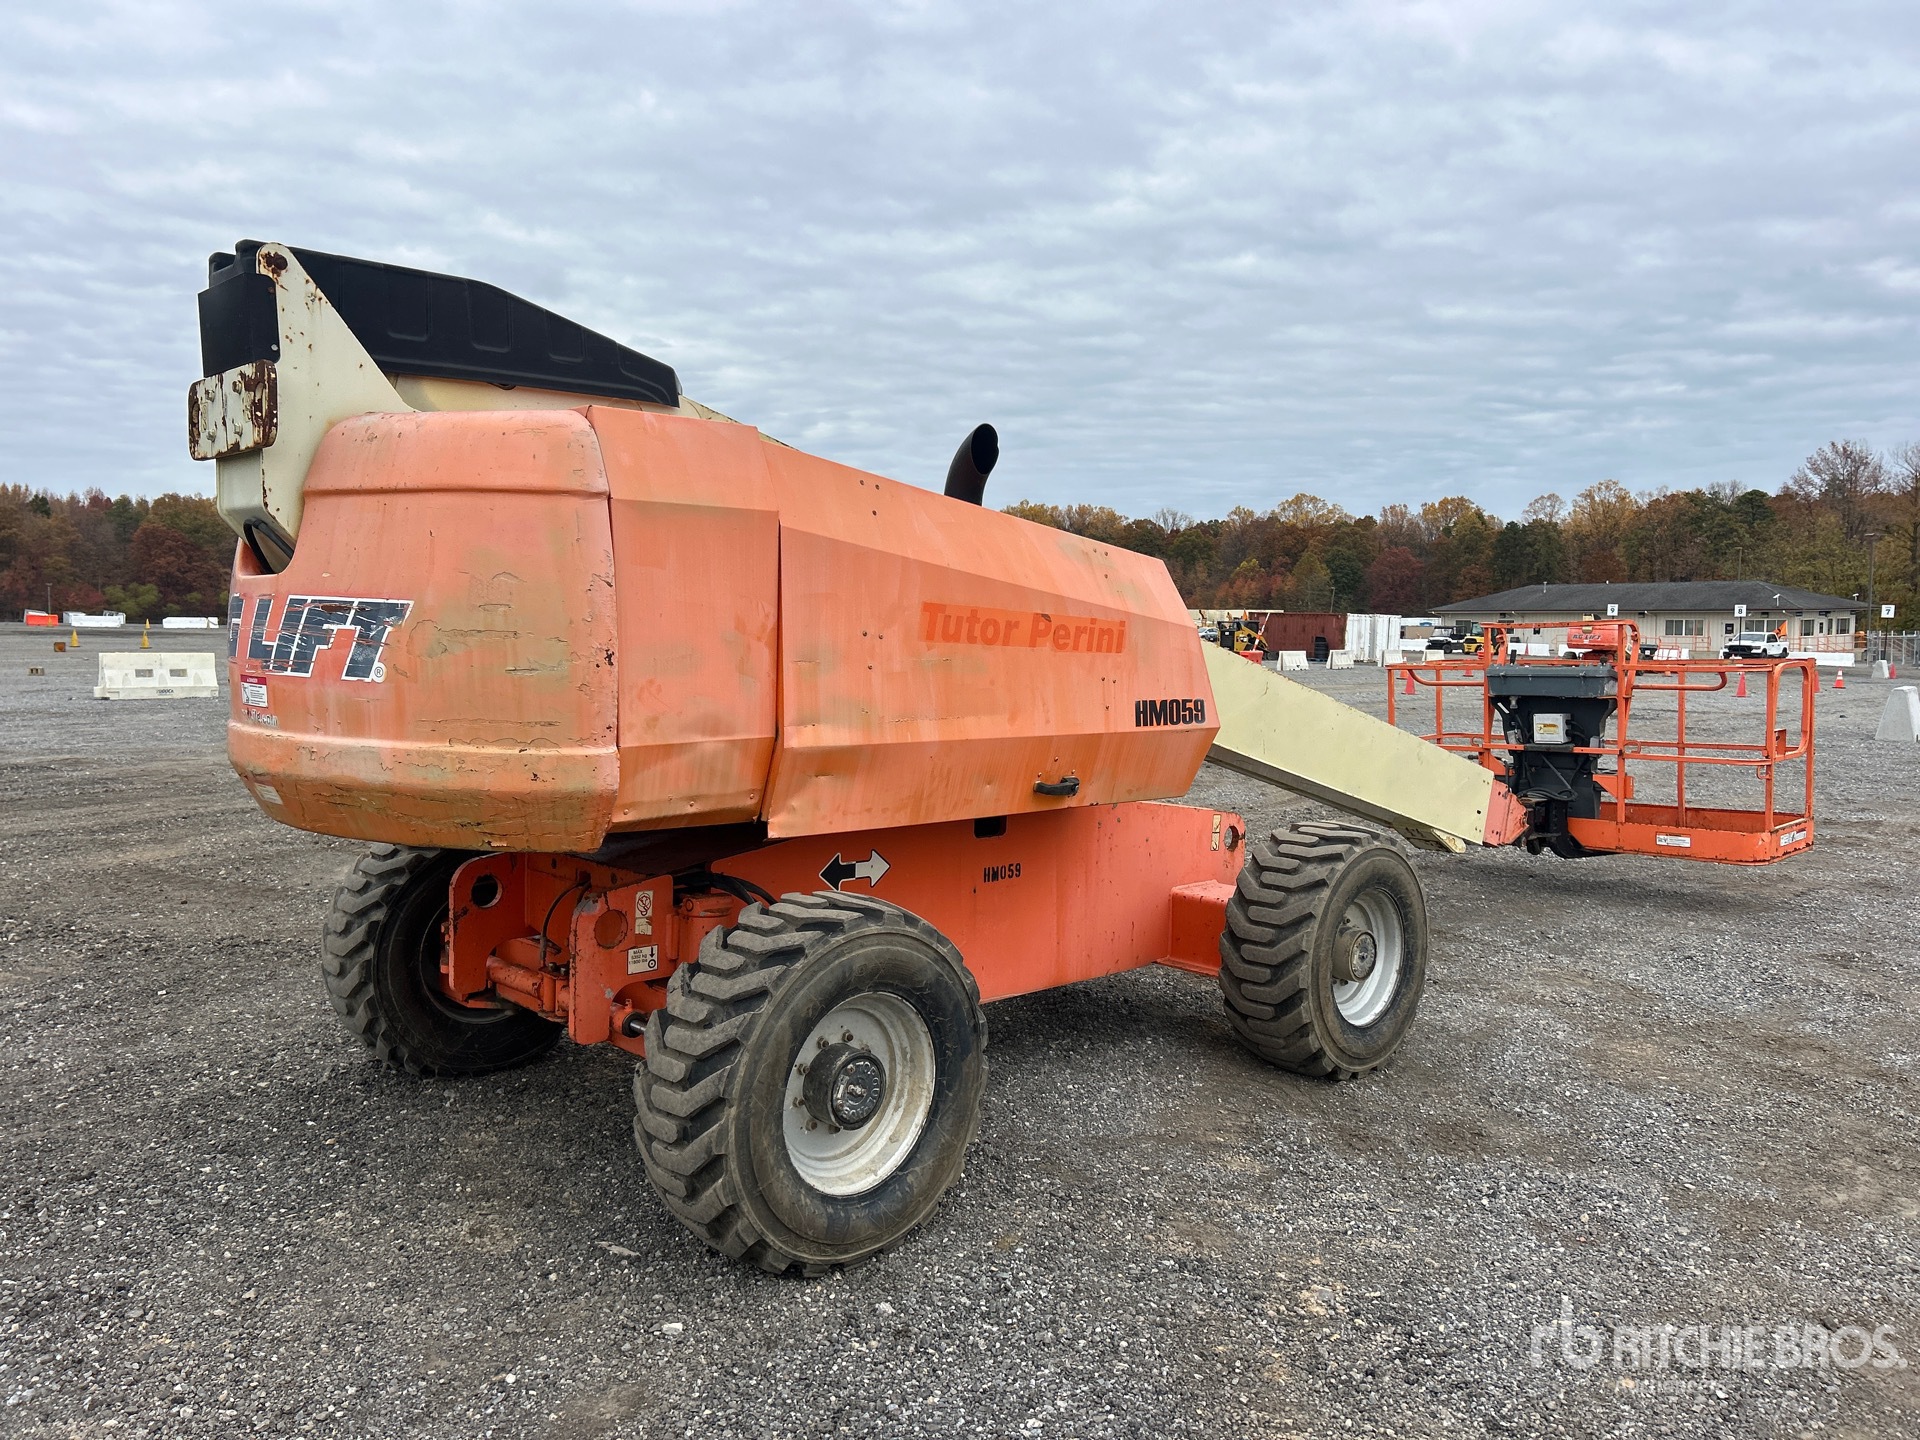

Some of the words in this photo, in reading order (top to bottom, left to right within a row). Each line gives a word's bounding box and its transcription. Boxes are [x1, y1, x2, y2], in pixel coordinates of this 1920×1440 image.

[921, 602, 1019, 647] Tutor
[1029, 613, 1126, 653] Perini
[1135, 698, 1205, 727] HM059
[983, 863, 1022, 883] HM059
